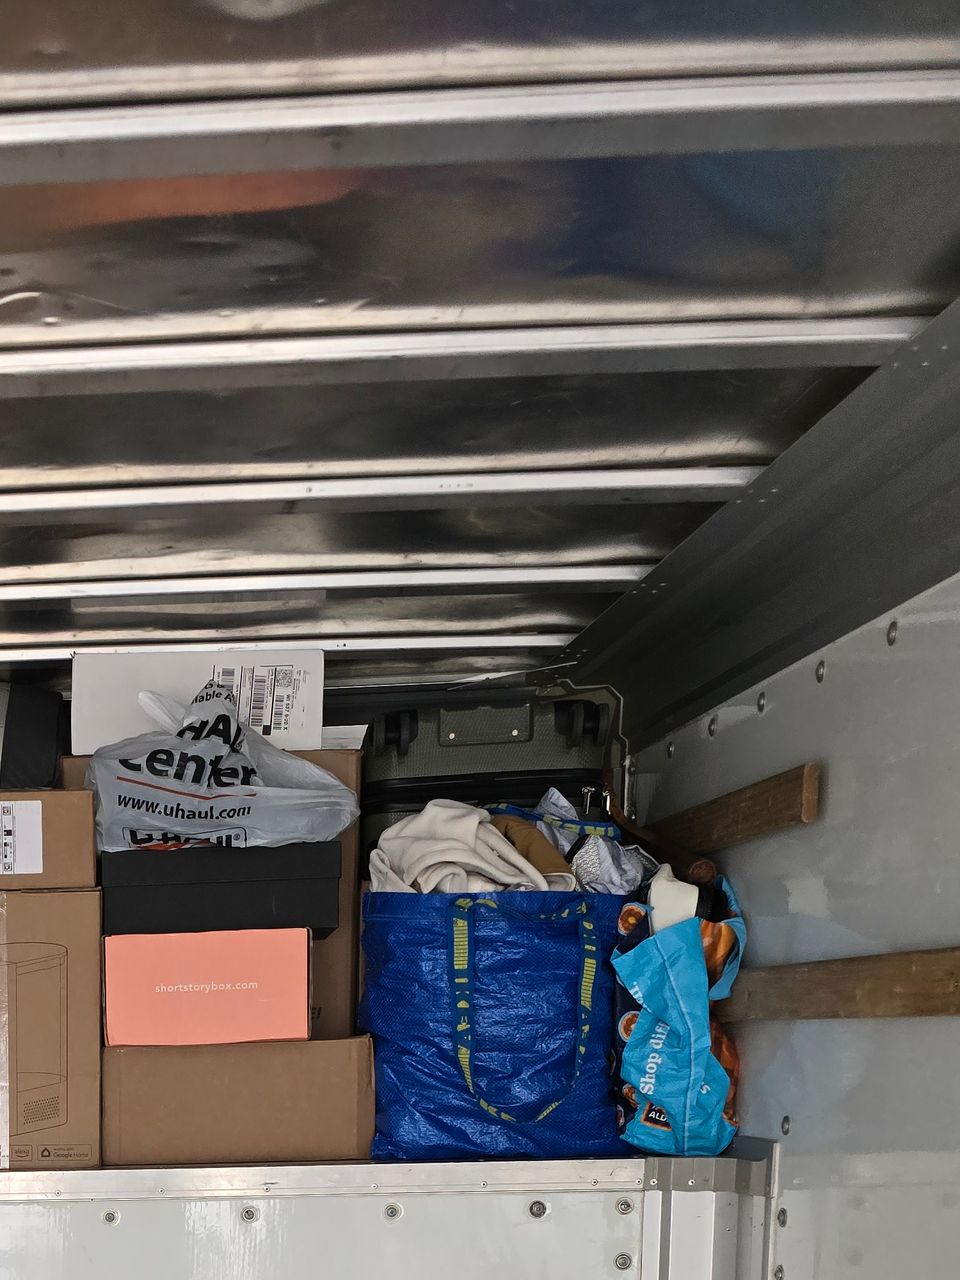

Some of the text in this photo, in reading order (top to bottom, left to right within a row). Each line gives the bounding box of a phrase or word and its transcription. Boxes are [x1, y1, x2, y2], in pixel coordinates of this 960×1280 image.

[117, 794, 252, 820] www.uhaul.com
[155, 981, 258, 993] shortstorybox.com
[640, 1052, 661, 1095] Shop
